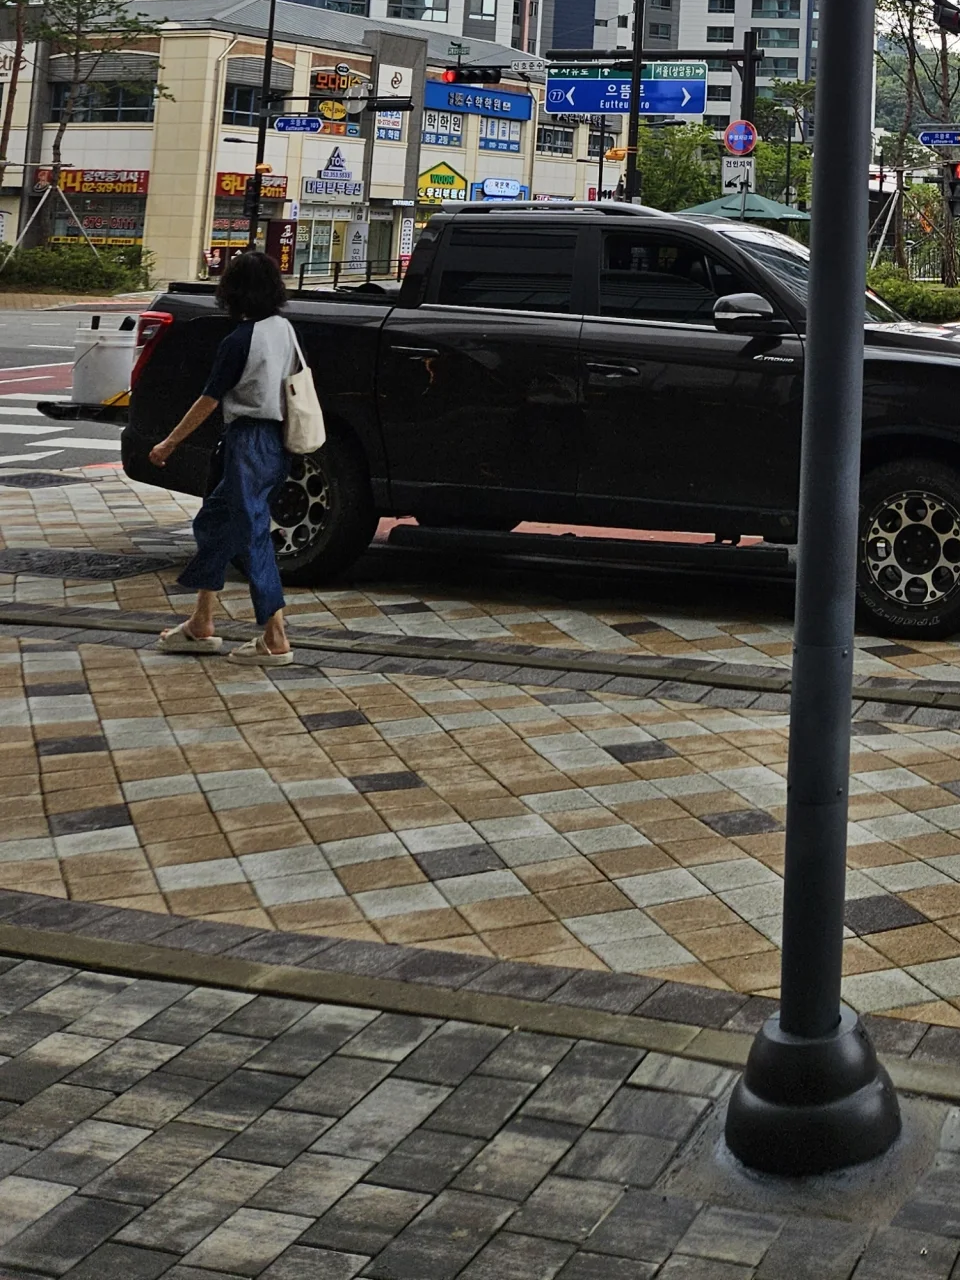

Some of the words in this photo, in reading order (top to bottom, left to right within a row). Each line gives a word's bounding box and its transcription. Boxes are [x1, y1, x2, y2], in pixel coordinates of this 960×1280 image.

[512, 62, 543, 70] 신호준수
[656, 65, 695, 78] 서울(상암동)
[551, 91, 562, 101] 77
[465, 95, 501, 111] 수학학원
[331, 157, 345, 165] TOP
[726, 160, 752, 168] 견인지역
[430, 174, 455, 185] WOORI
[82, 182, 137, 193] 02-379-0111
[426, 188, 466, 200] 우리부동산
